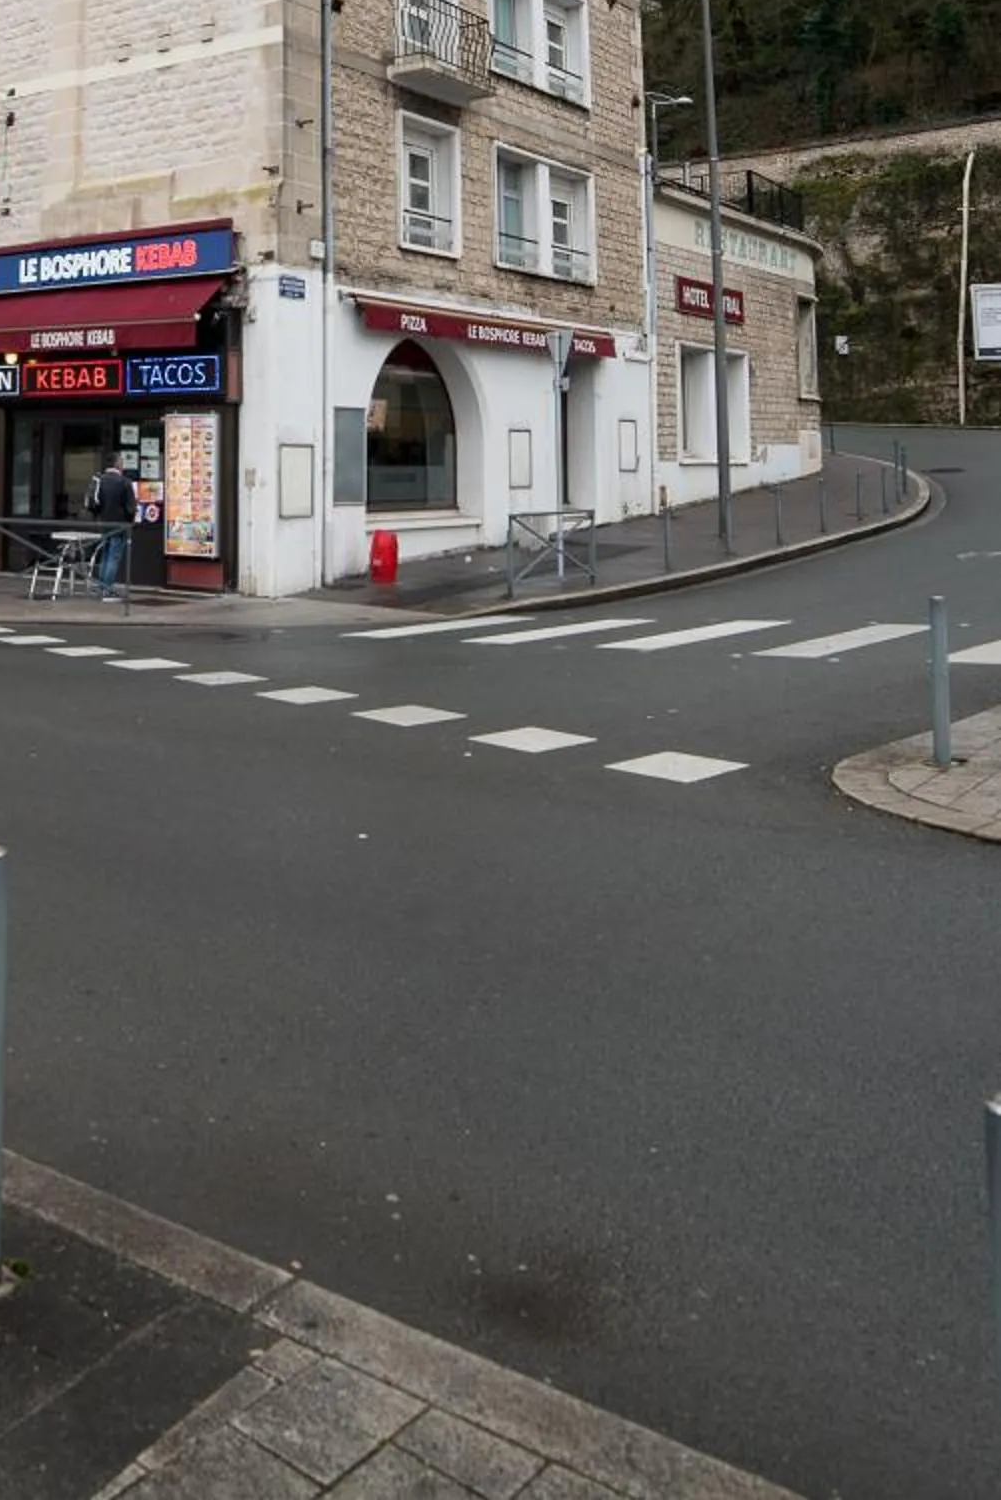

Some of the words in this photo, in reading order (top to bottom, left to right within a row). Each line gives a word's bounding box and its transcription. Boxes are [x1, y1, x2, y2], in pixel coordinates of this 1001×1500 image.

[695, 219, 796, 273] RSTAURANT
[19, 257, 37, 283] LE
[41, 247, 132, 281] BOSPHORE
[135, 239, 197, 271] KEBAB
[682, 286, 710, 309] HOTEL
[30, 333, 41, 348] LE
[42, 331, 84, 347] BOSPHORE
[87, 329, 115, 345] KEBAB
[400, 313, 427, 333] PIZZA
[479, 326, 520, 343] BOSPHORE
[522, 331, 548, 347] KEBAB
[572, 338, 596, 354] TACOS
[36, 367, 107, 390] KEBAB
[139, 363, 206, 387] TACOS
